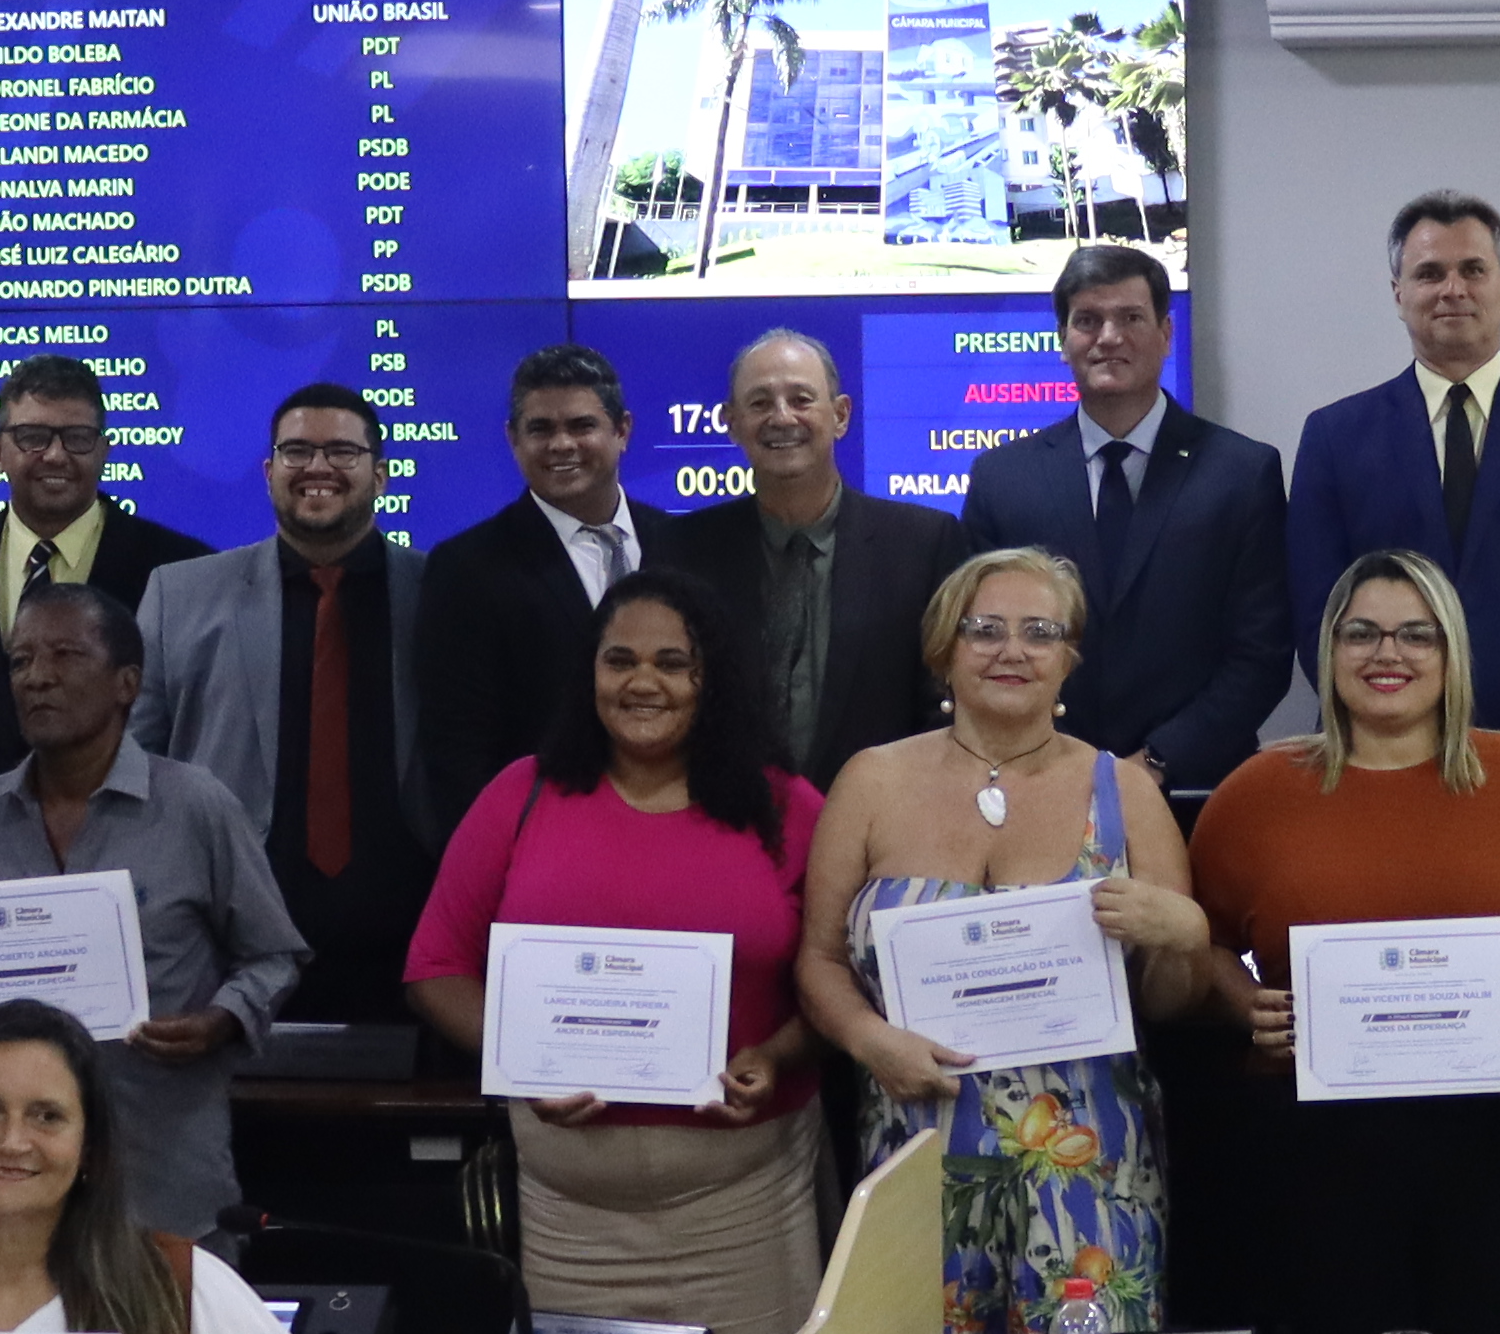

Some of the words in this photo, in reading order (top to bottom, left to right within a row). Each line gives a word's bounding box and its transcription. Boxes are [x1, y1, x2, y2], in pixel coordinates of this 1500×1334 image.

[89, 9, 164, 28] MAITAN
[314, 0, 378, 22] UNIÃO
[383, 2, 448, 21] BRASIL
[936, 18, 986, 28] MUNICIPAL
[48, 44, 120, 63] BOLEBA
[363, 37, 400, 55] PDT
[69, 73, 154, 95] FABRÍCIO
[371, 71, 393, 88] PL
[56, 112, 83, 130] DA
[89, 106, 186, 129] FARMÁCIA
[372, 105, 394, 122] PL
[64, 144, 148, 163] MACEDO
[359, 138, 408, 156] PSDB
[68, 178, 133, 197] MARIN
[358, 172, 410, 190] PODE
[33, 212, 134, 231] MACHADO
[367, 206, 403, 224] PDT
[27, 247, 68, 265] LUIZ
[73, 241, 179, 264] CALEGÁRIO
[374, 240, 398, 258] PP
[89, 278, 180, 297] PINHEIRO
[186, 277, 251, 295] DUTRA
[362, 274, 411, 292] PSDB
[45, 325, 108, 343] MELLO
[377, 320, 398, 337] PL
[954, 331, 1062, 353] PRESENTE
[371, 354, 405, 371] PSB
[102, 393, 159, 410] ARECA
[363, 388, 414, 406] PODE
[964, 382, 1081, 403] AUSENTES
[668, 402, 728, 435] 17:0
[105, 427, 183, 445] OTOBOY
[393, 423, 458, 441] BRASIL
[101, 463, 142, 481] EIRA
[374, 496, 410, 513] PDT
[991, 924, 1031, 936] Municipal
[921, 973, 952, 985] MARIA
[955, 971, 969, 981] DA
[1373, 994, 1411, 1004] VICENTE
[1414, 993, 1427, 1002] DE
[1429, 992, 1460, 1001] SOUZA
